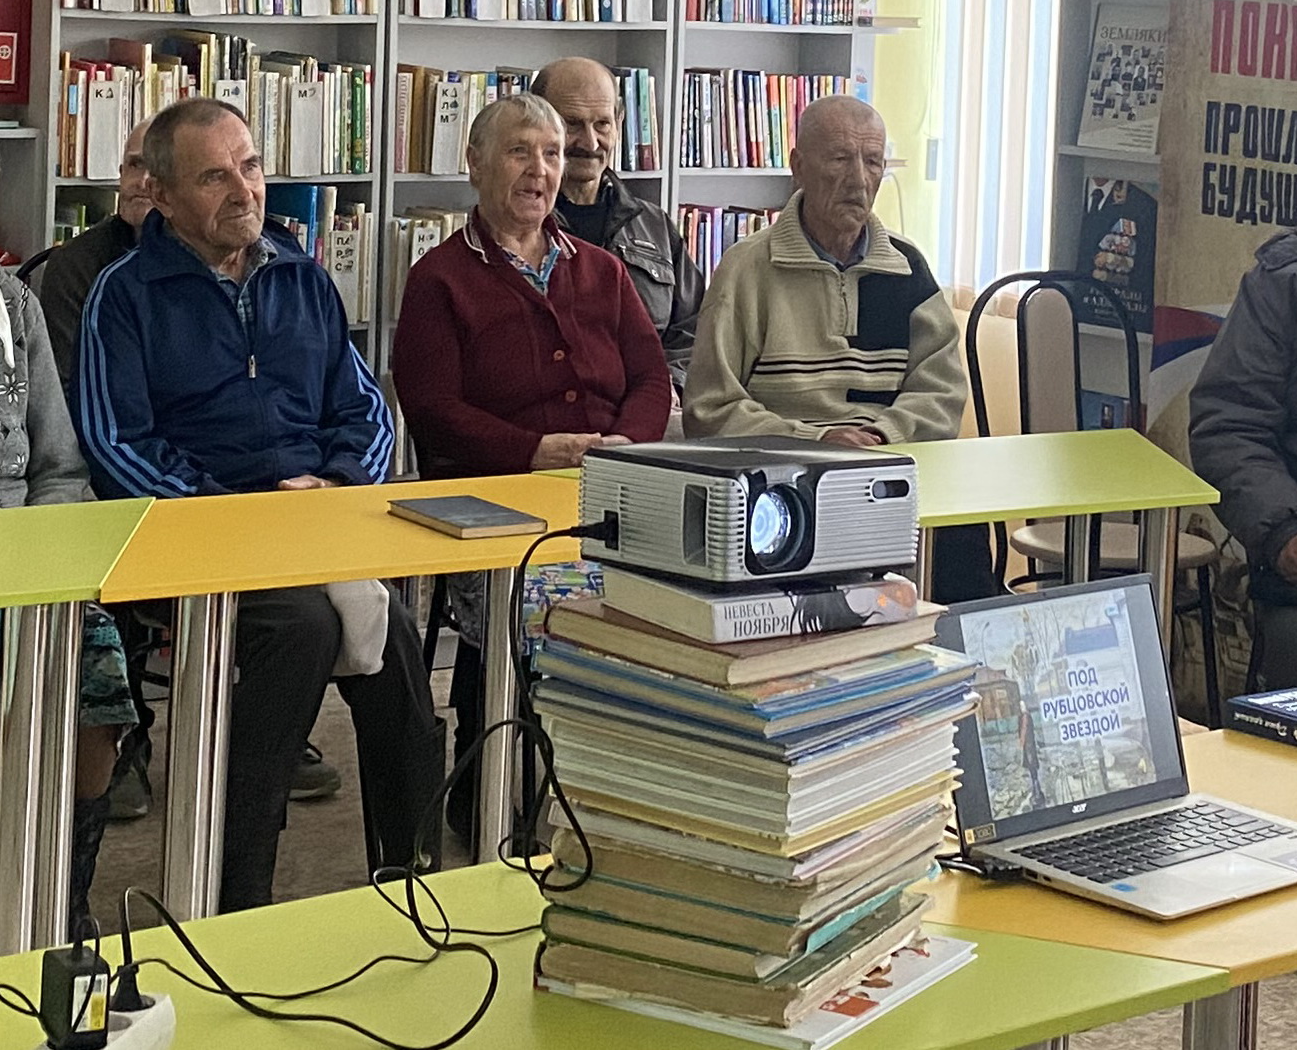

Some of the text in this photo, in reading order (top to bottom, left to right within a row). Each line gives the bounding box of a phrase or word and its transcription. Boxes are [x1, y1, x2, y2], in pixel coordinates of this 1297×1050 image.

[95, 89, 103, 98] К
[222, 88, 230, 97] Л
[298, 90, 307, 98] М
[442, 88, 448, 98] К
[441, 102, 449, 110] Л
[440, 114, 449, 124] М
[724, 602, 774, 620] НЕВЕСТА
[734, 615, 790, 638] НОЯБРЯ
[1068, 667, 1099, 688] ПОД
[1042, 682, 1130, 720] РУБЦОВСКОЙ
[1060, 710, 1120, 741] ЗВЕЗДОЙ
[1072, 803, 1088, 814] acer
